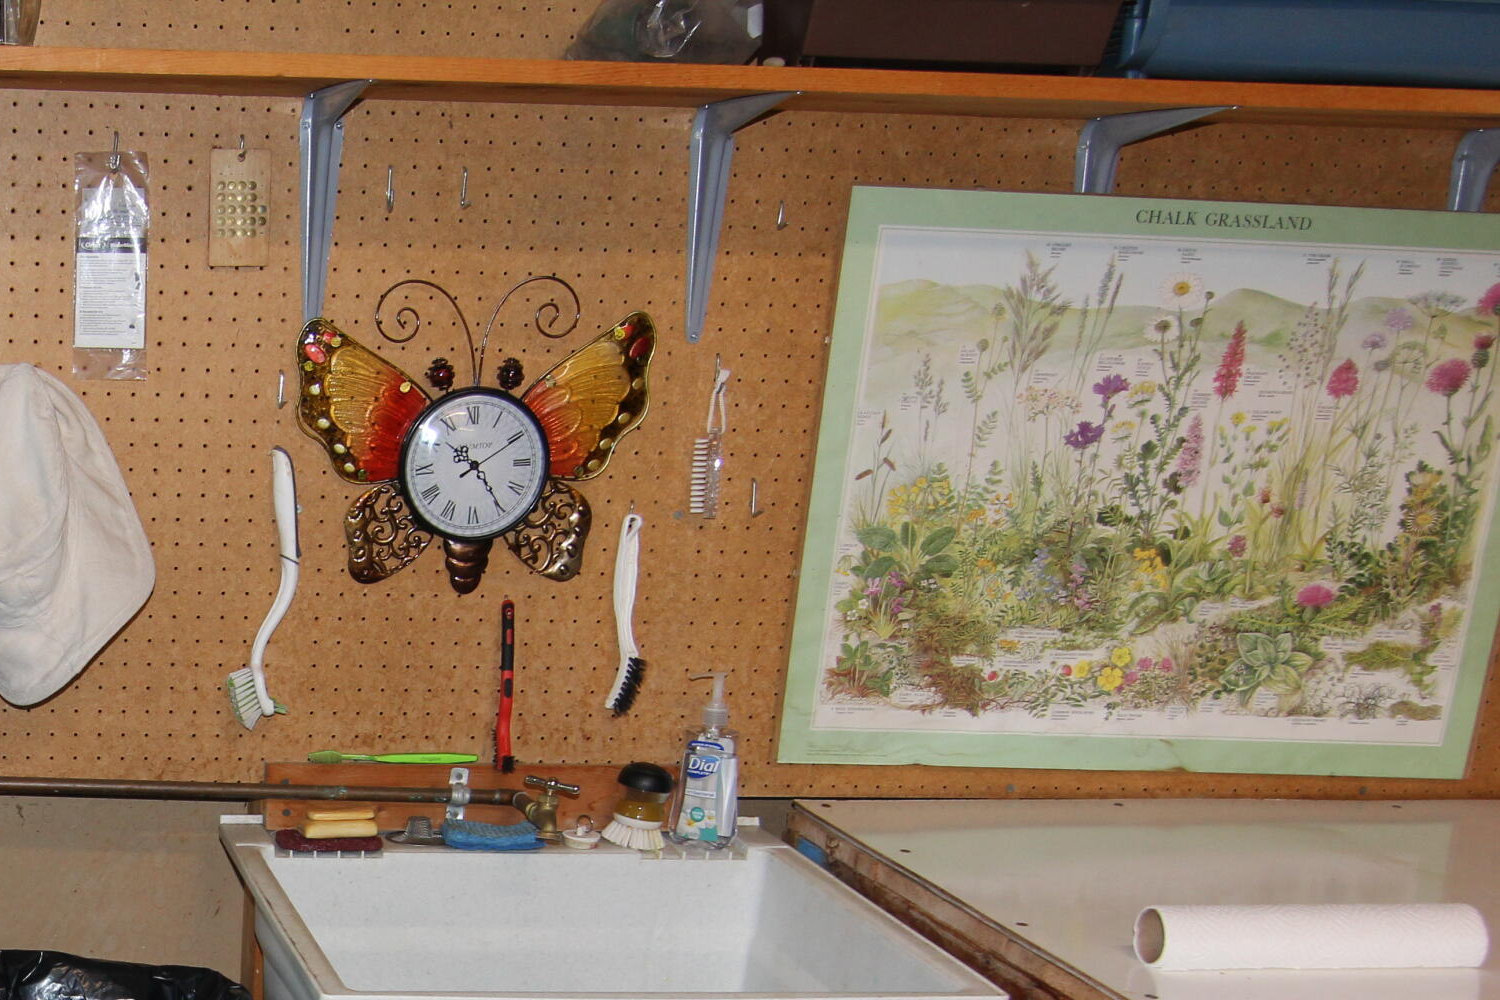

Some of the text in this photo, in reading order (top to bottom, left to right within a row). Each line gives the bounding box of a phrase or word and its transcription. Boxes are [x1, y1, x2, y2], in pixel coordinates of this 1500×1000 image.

[1136, 209, 1312, 231] CHALK GRASSLAND
[466, 406, 480, 425] XII
[513, 458, 531, 467] III
[688, 757, 720, 773] Dial
